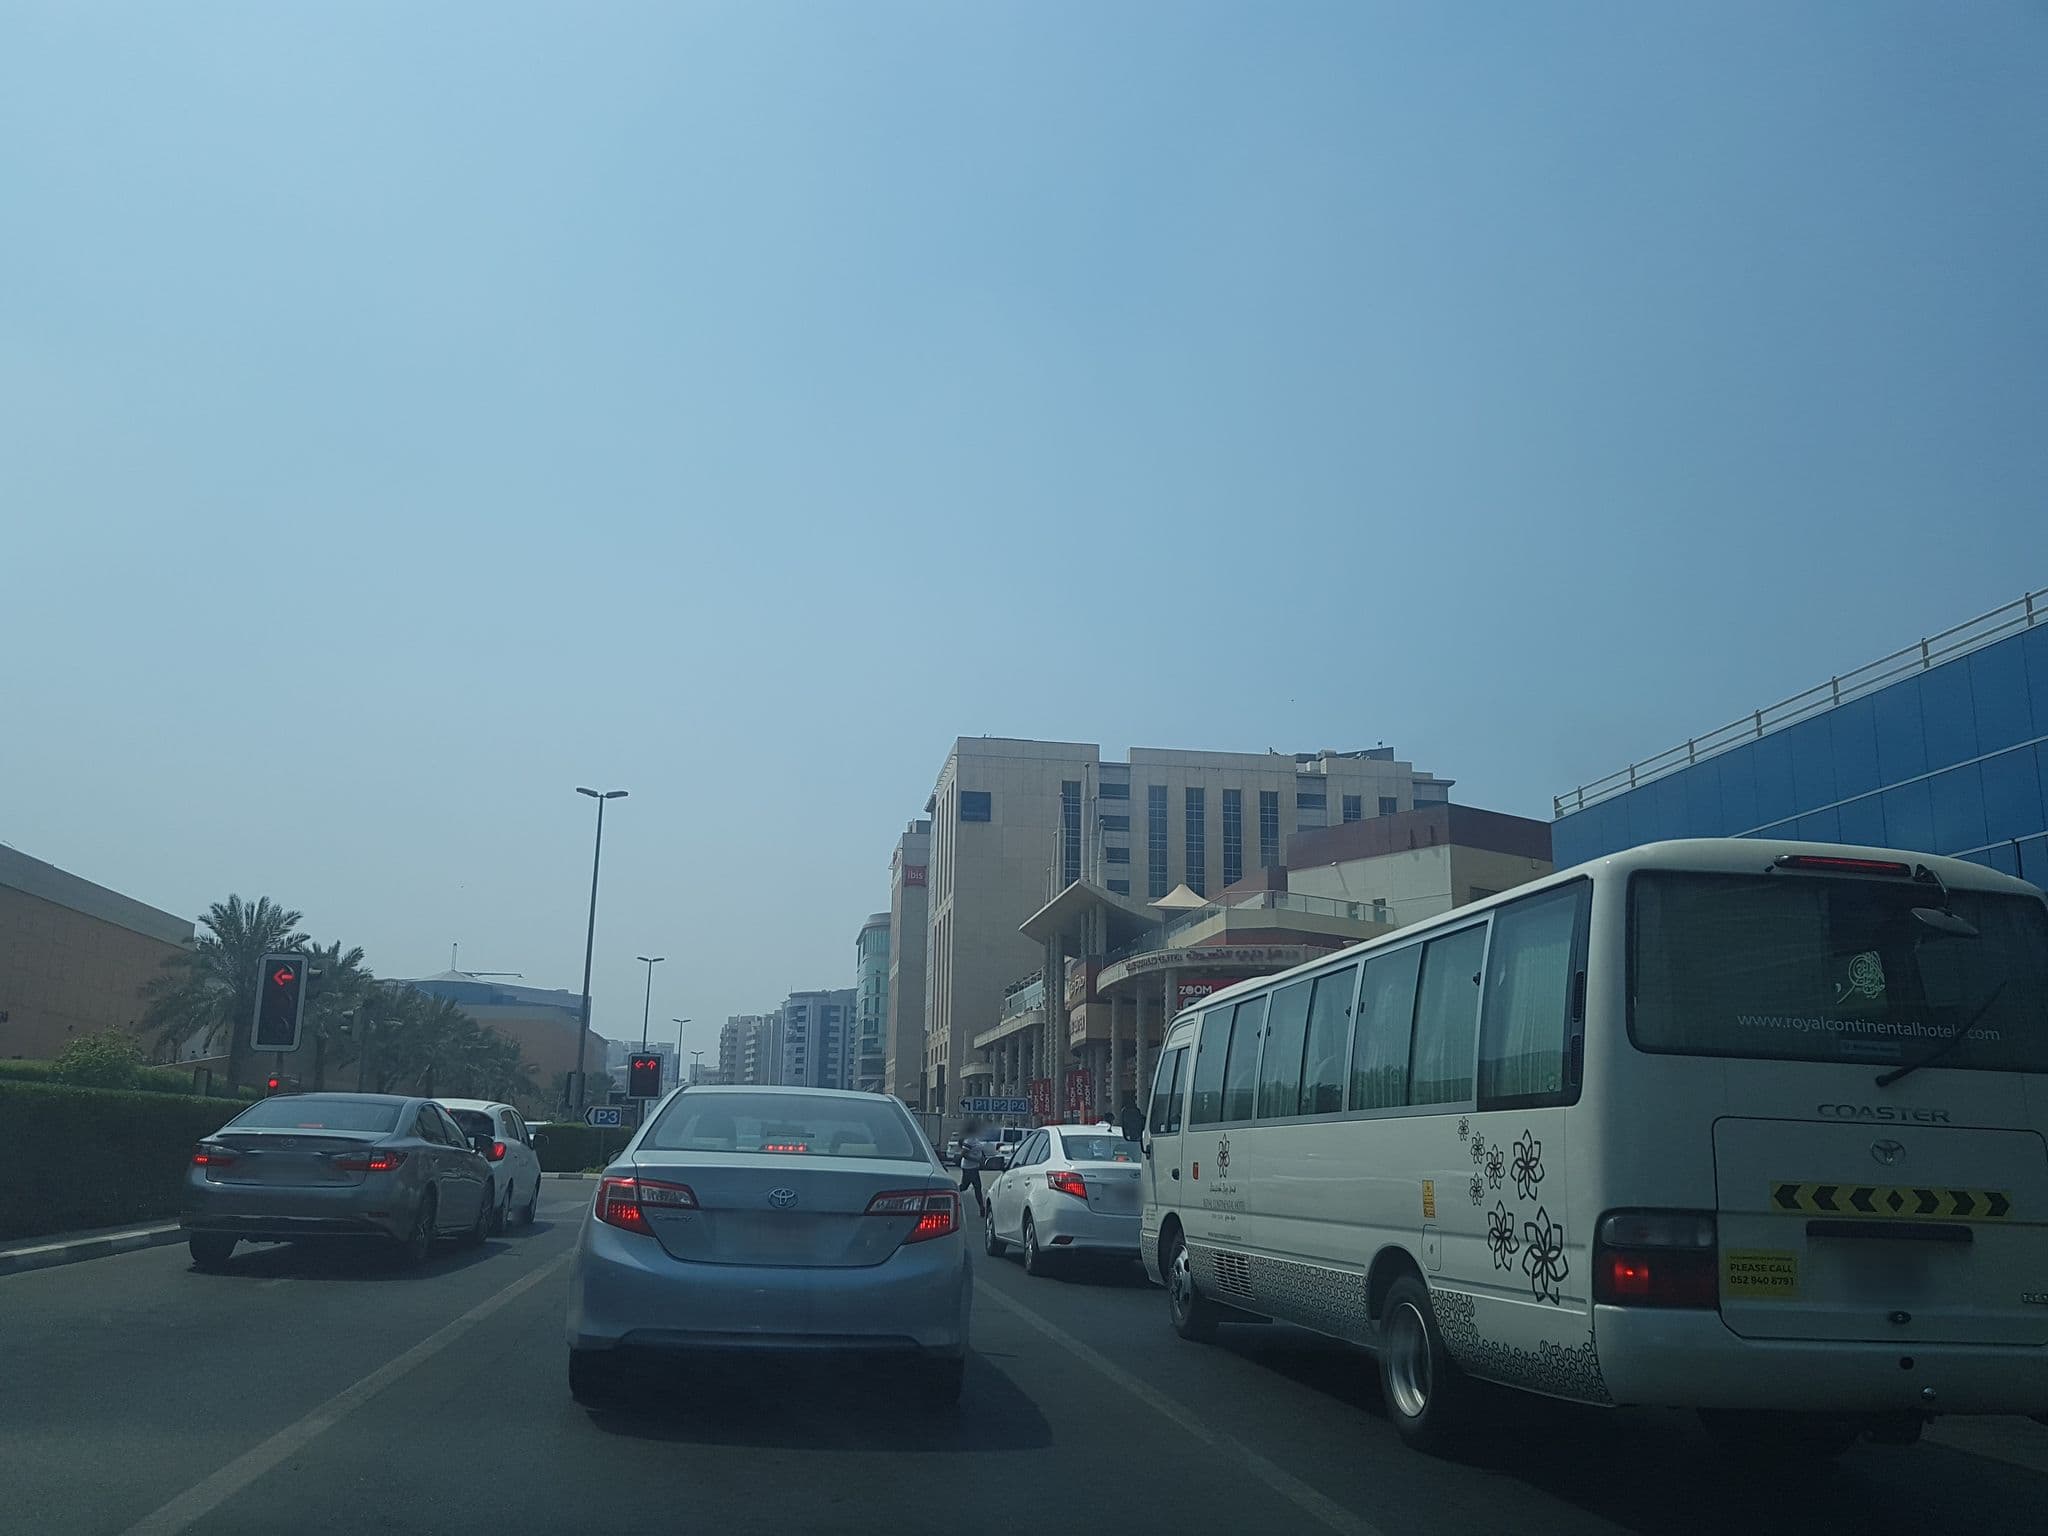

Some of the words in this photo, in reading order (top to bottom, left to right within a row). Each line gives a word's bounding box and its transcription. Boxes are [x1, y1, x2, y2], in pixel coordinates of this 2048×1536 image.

[907, 869, 924, 879] ibis
[1178, 985, 1212, 995] ZOOM
[975, 1100, 988, 1111] P1
[993, 1100, 1009, 1111] P2
[1011, 1100, 1026, 1111] P4
[597, 1110, 618, 1123] P3
[1817, 1103, 1952, 1124] COASTER
[1730, 1263, 1767, 1273] PLEASE
[1769, 1264, 1793, 1274] CALL
[1730, 1275, 1749, 1285] 052
